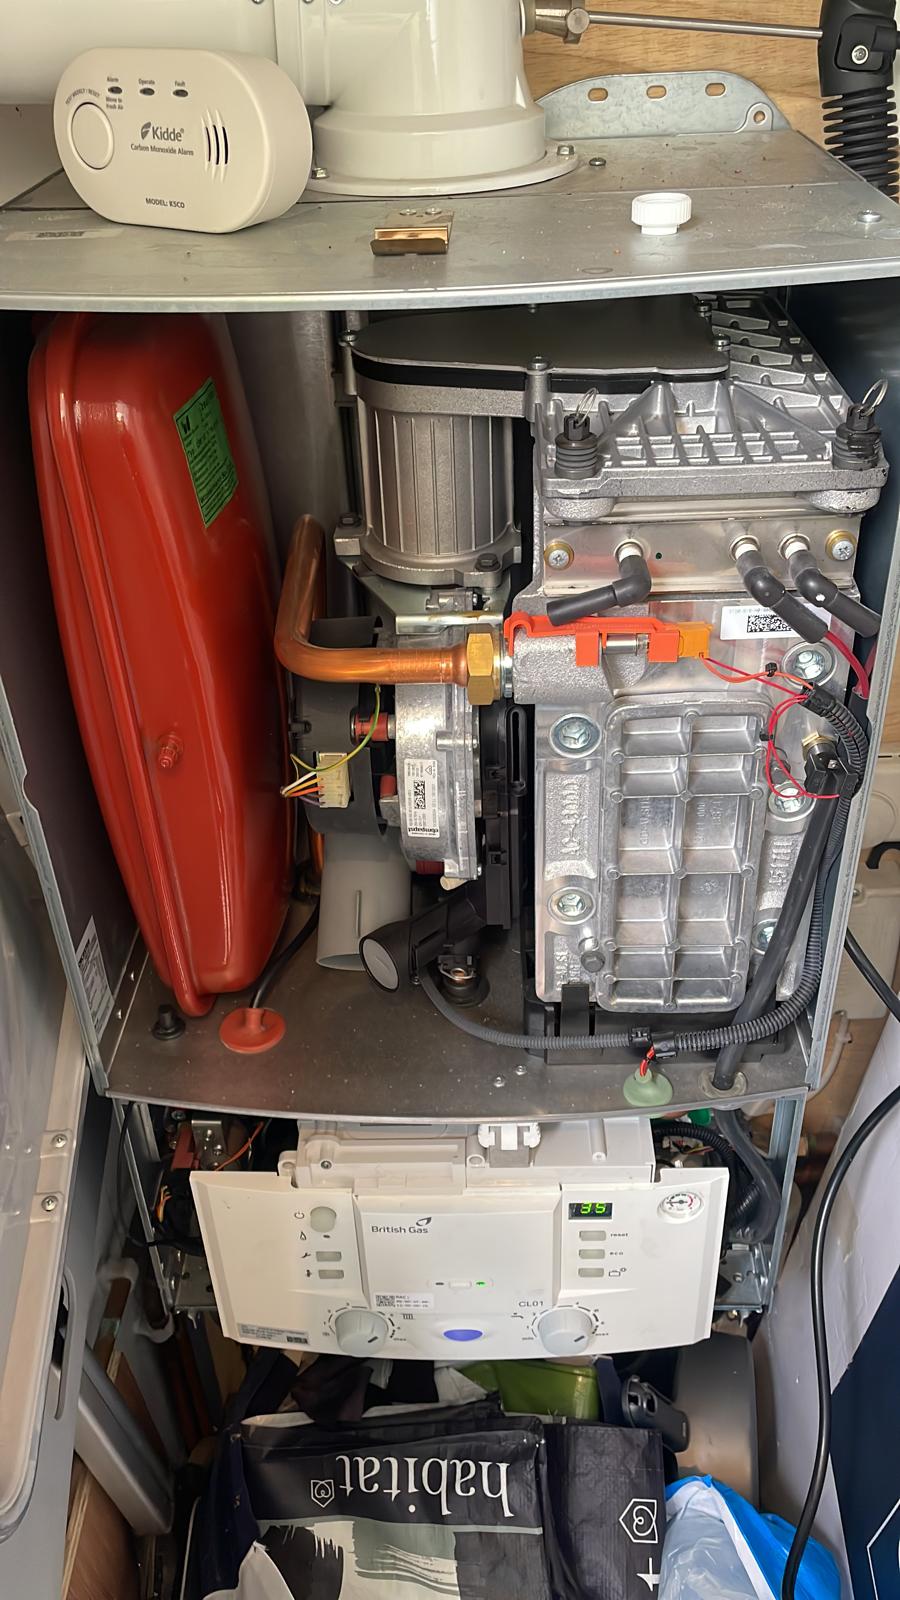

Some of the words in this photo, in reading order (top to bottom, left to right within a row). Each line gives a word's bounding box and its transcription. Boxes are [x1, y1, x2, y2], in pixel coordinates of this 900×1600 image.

[138, 78, 155, 86] Operate
[152, 126, 182, 141] Kidde
[131, 143, 149, 152] Carbon
[150, 145, 177, 154] Monoxide
[178, 147, 194, 156] Alarm
[371, 1225, 406, 1234] British
[408, 1226, 429, 1234] Gas
[336, 1455, 515, 1517] habitat
